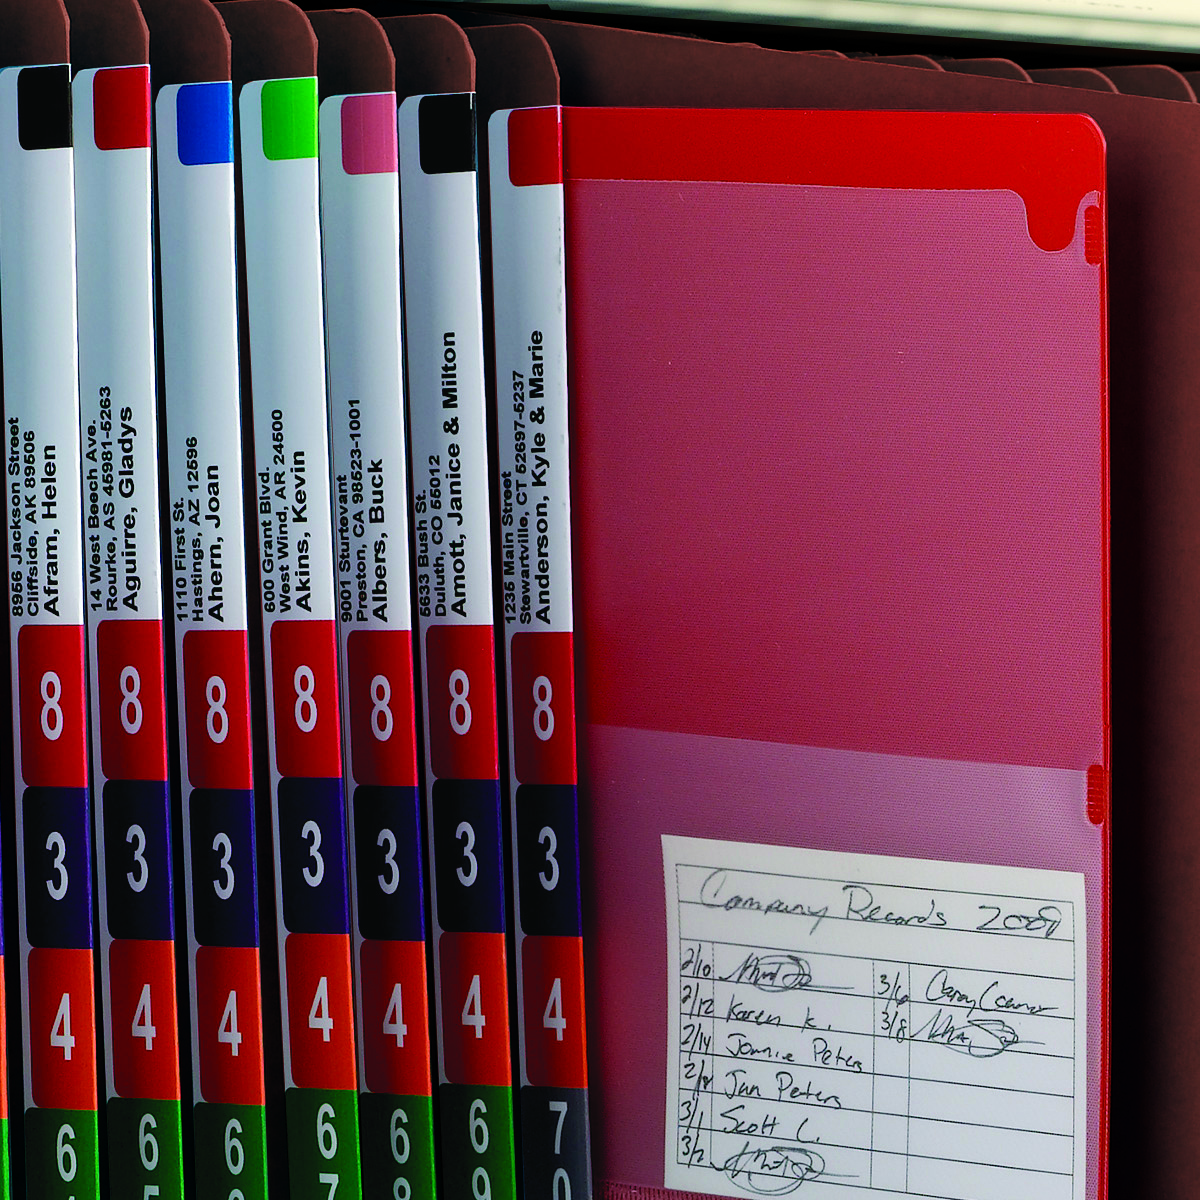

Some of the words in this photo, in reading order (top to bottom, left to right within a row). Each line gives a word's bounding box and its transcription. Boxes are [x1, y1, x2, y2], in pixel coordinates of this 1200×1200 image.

[440, 331, 458, 409] Milton
[527, 330, 545, 399] Marie
[7, 417, 21, 476] Street
[85, 419, 98, 463] Ave.
[271, 409, 285, 466] 24500
[442, 416, 460, 436] &
[529, 405, 545, 425] &
[40, 445, 57, 520] Helen
[117, 406, 137, 499] Gladys
[445, 442, 464, 527] Janice
[530, 432, 550, 487] Kyle
[24, 494, 37, 525] AK
[86, 468, 100, 529] Beech
[102, 501, 116, 531] AS
[172, 497, 185, 523] St.
[187, 498, 201, 527] AZ
[204, 465, 221, 529] Joan
[257, 466, 272, 515] Blvd.
[273, 470, 287, 500] AR
[289, 451, 308, 523] Kevin
[366, 458, 385, 524] Buck
[9, 482, 23, 566] Jackson
[173, 527, 187, 571] First
[260, 519, 274, 574] Grant
[275, 506, 289, 561] Wind,
[25, 530, 40, 617] Cliffside,
[43, 528, 61, 617] Afram,
[88, 534, 102, 585] West
[104, 536, 118, 612] Rourke,
[120, 507, 142, 612] Aguirre,
[190, 532, 205, 622] Hastings,
[207, 536, 224, 623] Ahern,
[278, 564, 292, 614] West
[294, 532, 312, 613] Akins,
[371, 532, 389, 623] Albers,
[448, 534, 467, 618] Amott,
[534, 495, 551, 625] Anderson,
[90, 588, 103, 612] 14
[175, 577, 189, 622] 1110
[262, 579, 276, 613] 600
[41, 671, 63, 740] 8
[294, 665, 317, 732] 8
[533, 676, 554, 741] 8
[46, 832, 68, 900] 3
[302, 820, 324, 887] 3
[538, 826, 559, 891] 3
[700, 869, 829, 936] Company
[843, 885, 947, 927] Records
[51, 993, 75, 1060] 4
[309, 977, 333, 1042] 4
[544, 978, 566, 1041] 4
[726, 994, 780, 1027] Karen
[813, 1038, 863, 1073] Peters
[720, 1105, 779, 1135] Scott
[776, 1071, 841, 1108] Peters
